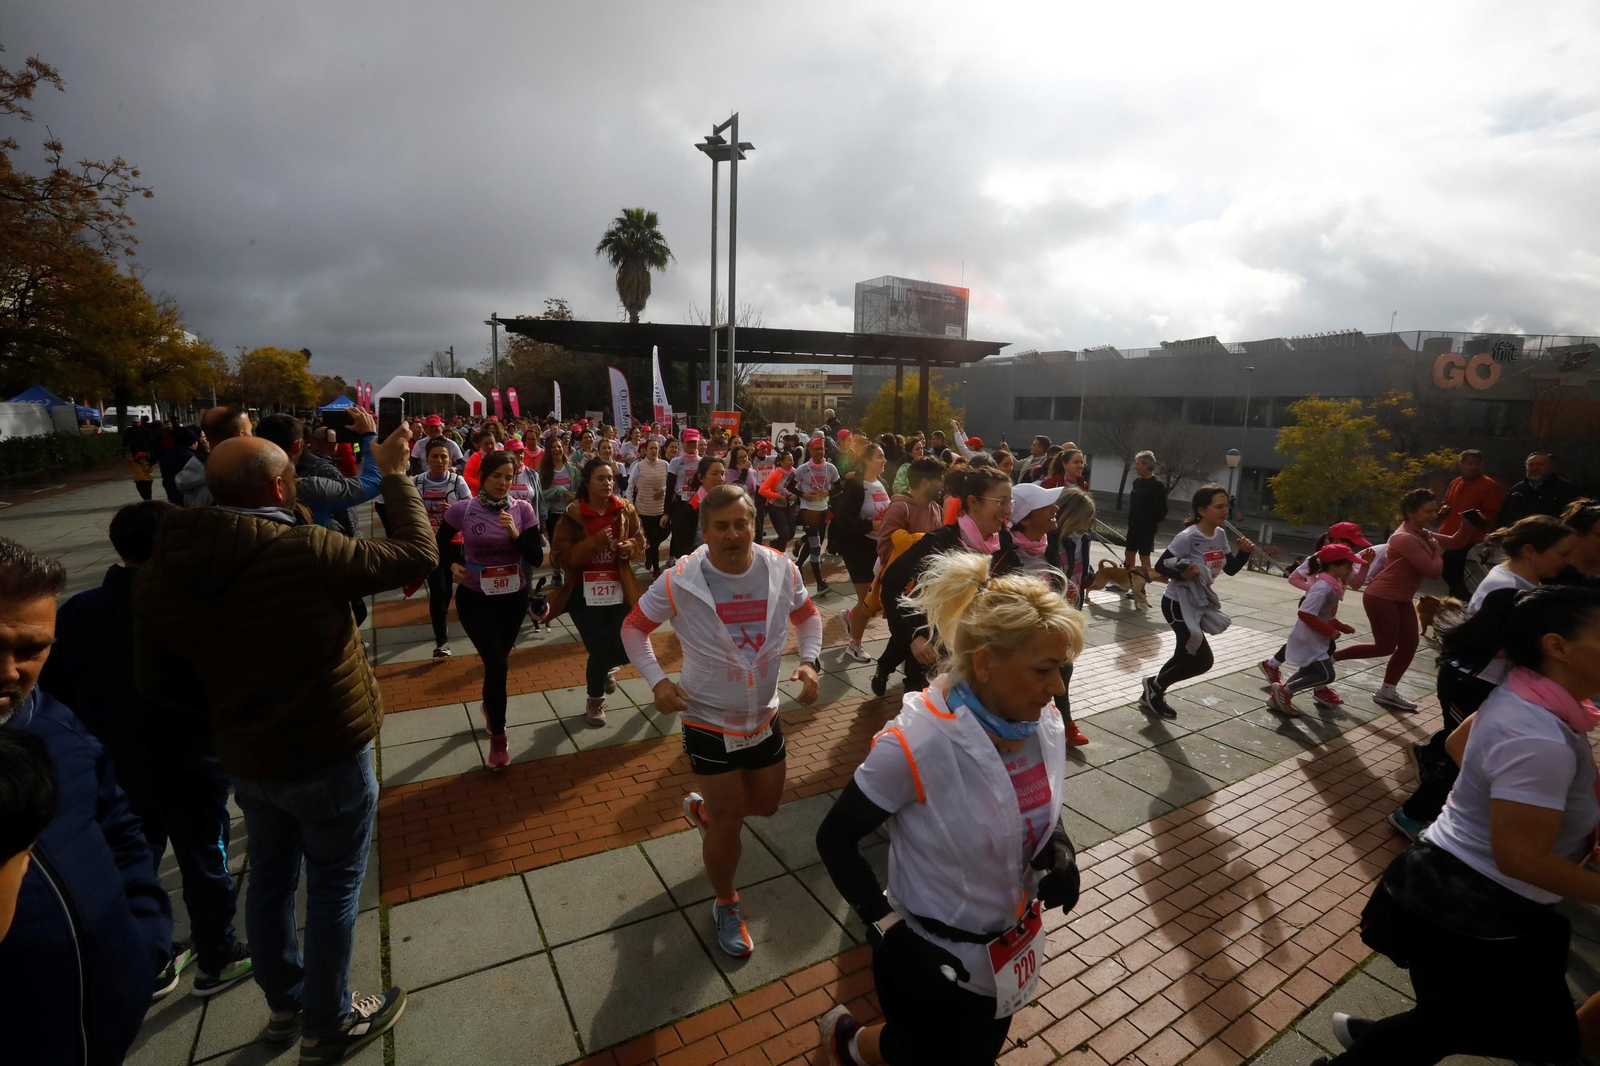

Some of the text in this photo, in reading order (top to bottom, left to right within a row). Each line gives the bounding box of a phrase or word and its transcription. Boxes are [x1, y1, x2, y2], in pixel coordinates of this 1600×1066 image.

[1433, 353, 1502, 391] GO
[493, 578, 509, 589] 587
[590, 585, 616, 596] 1217
[722, 607, 765, 617] PINK RUNNING
[1013, 949, 1037, 991] 220
